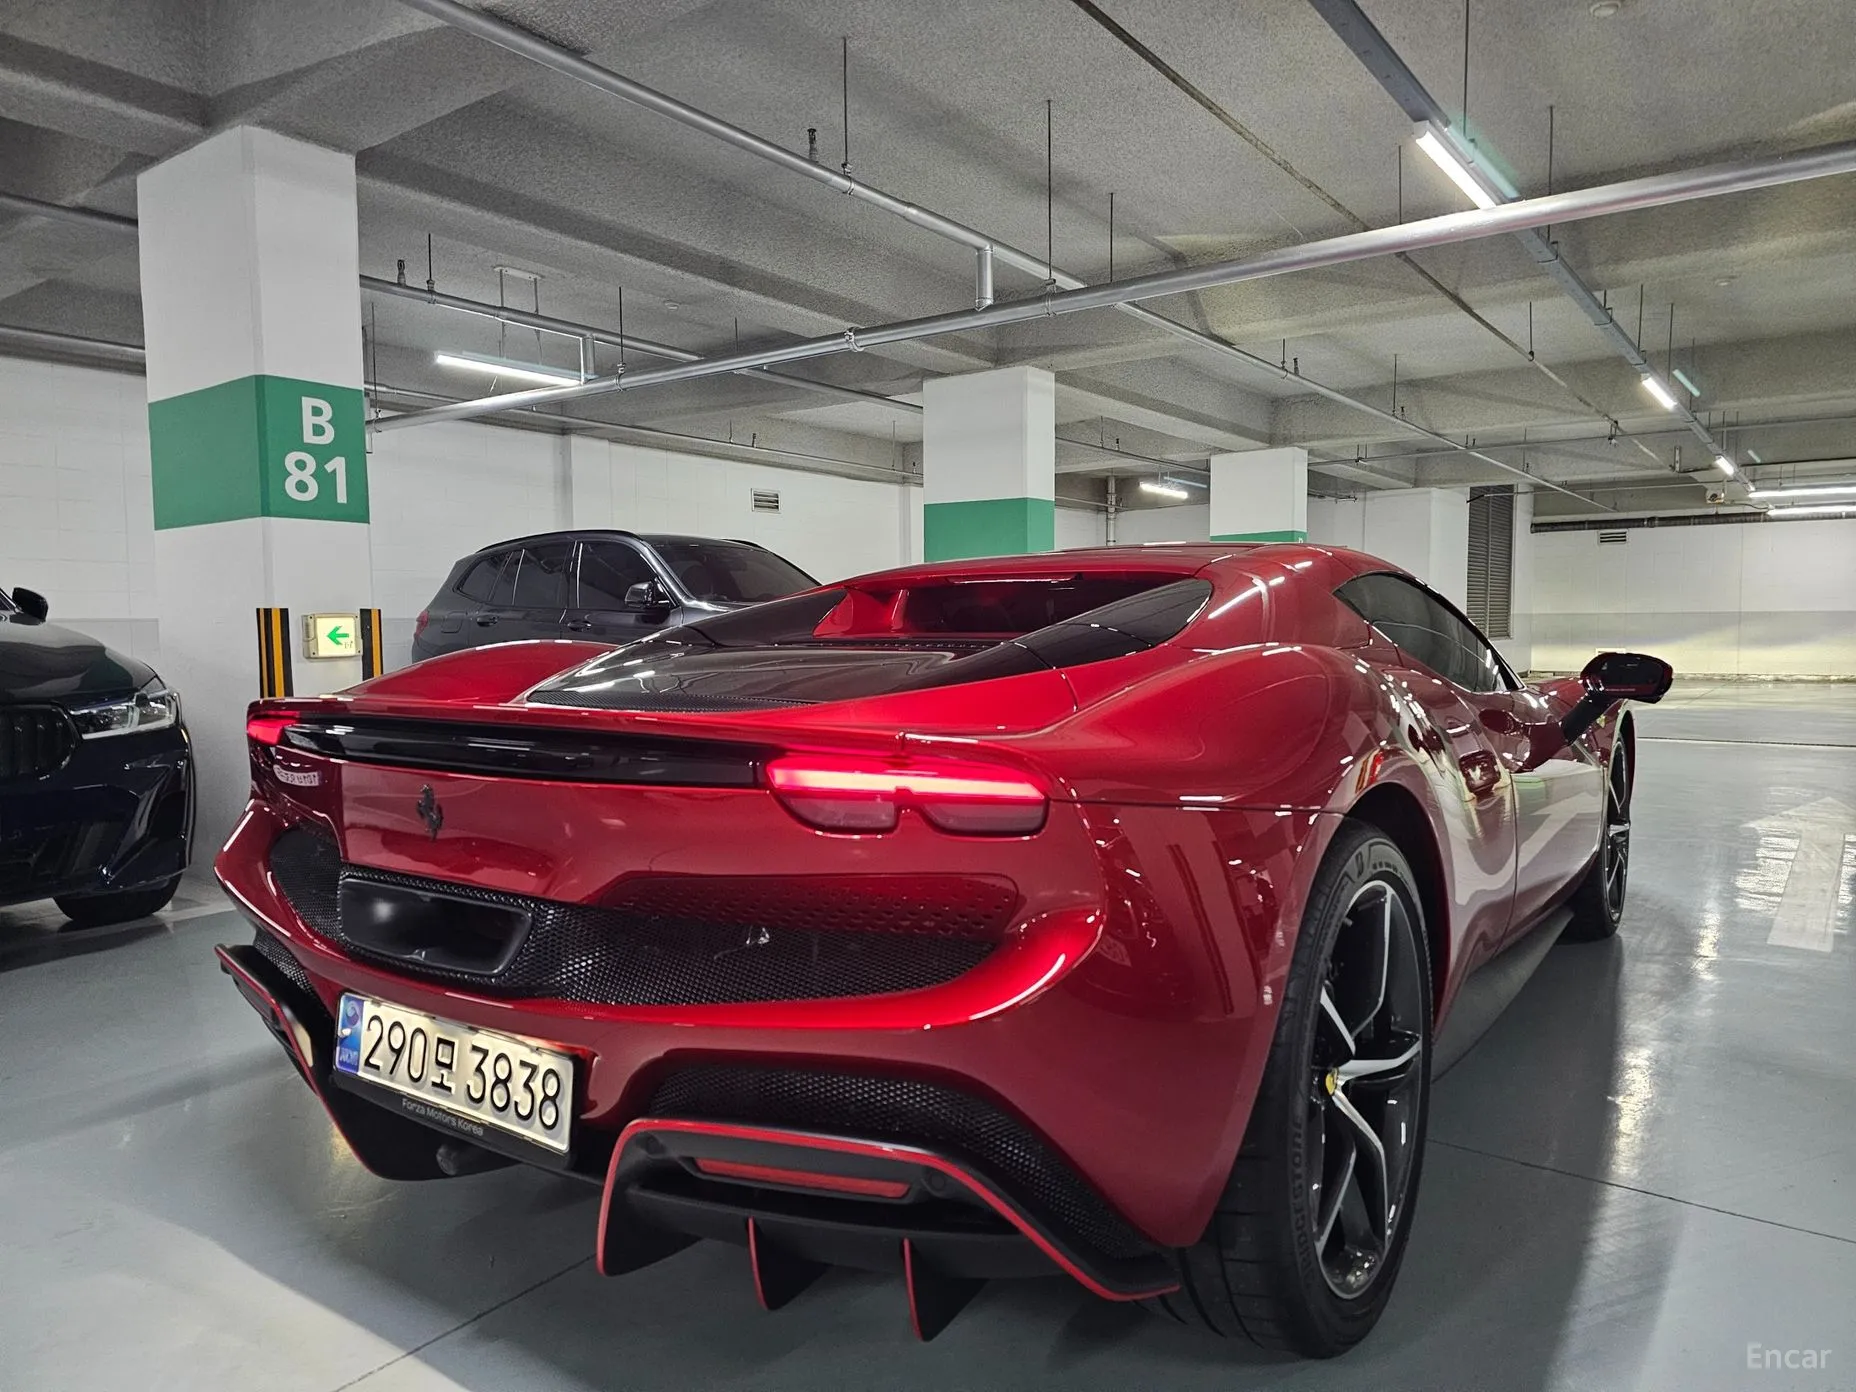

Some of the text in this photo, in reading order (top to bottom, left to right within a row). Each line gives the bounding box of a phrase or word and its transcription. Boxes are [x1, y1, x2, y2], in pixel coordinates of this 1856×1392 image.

[301, 396, 335, 445] B
[284, 451, 347, 504] 81
[363, 1014, 561, 1131] 290모 3838
[402, 1098, 484, 1136] Forza Motors Korea
